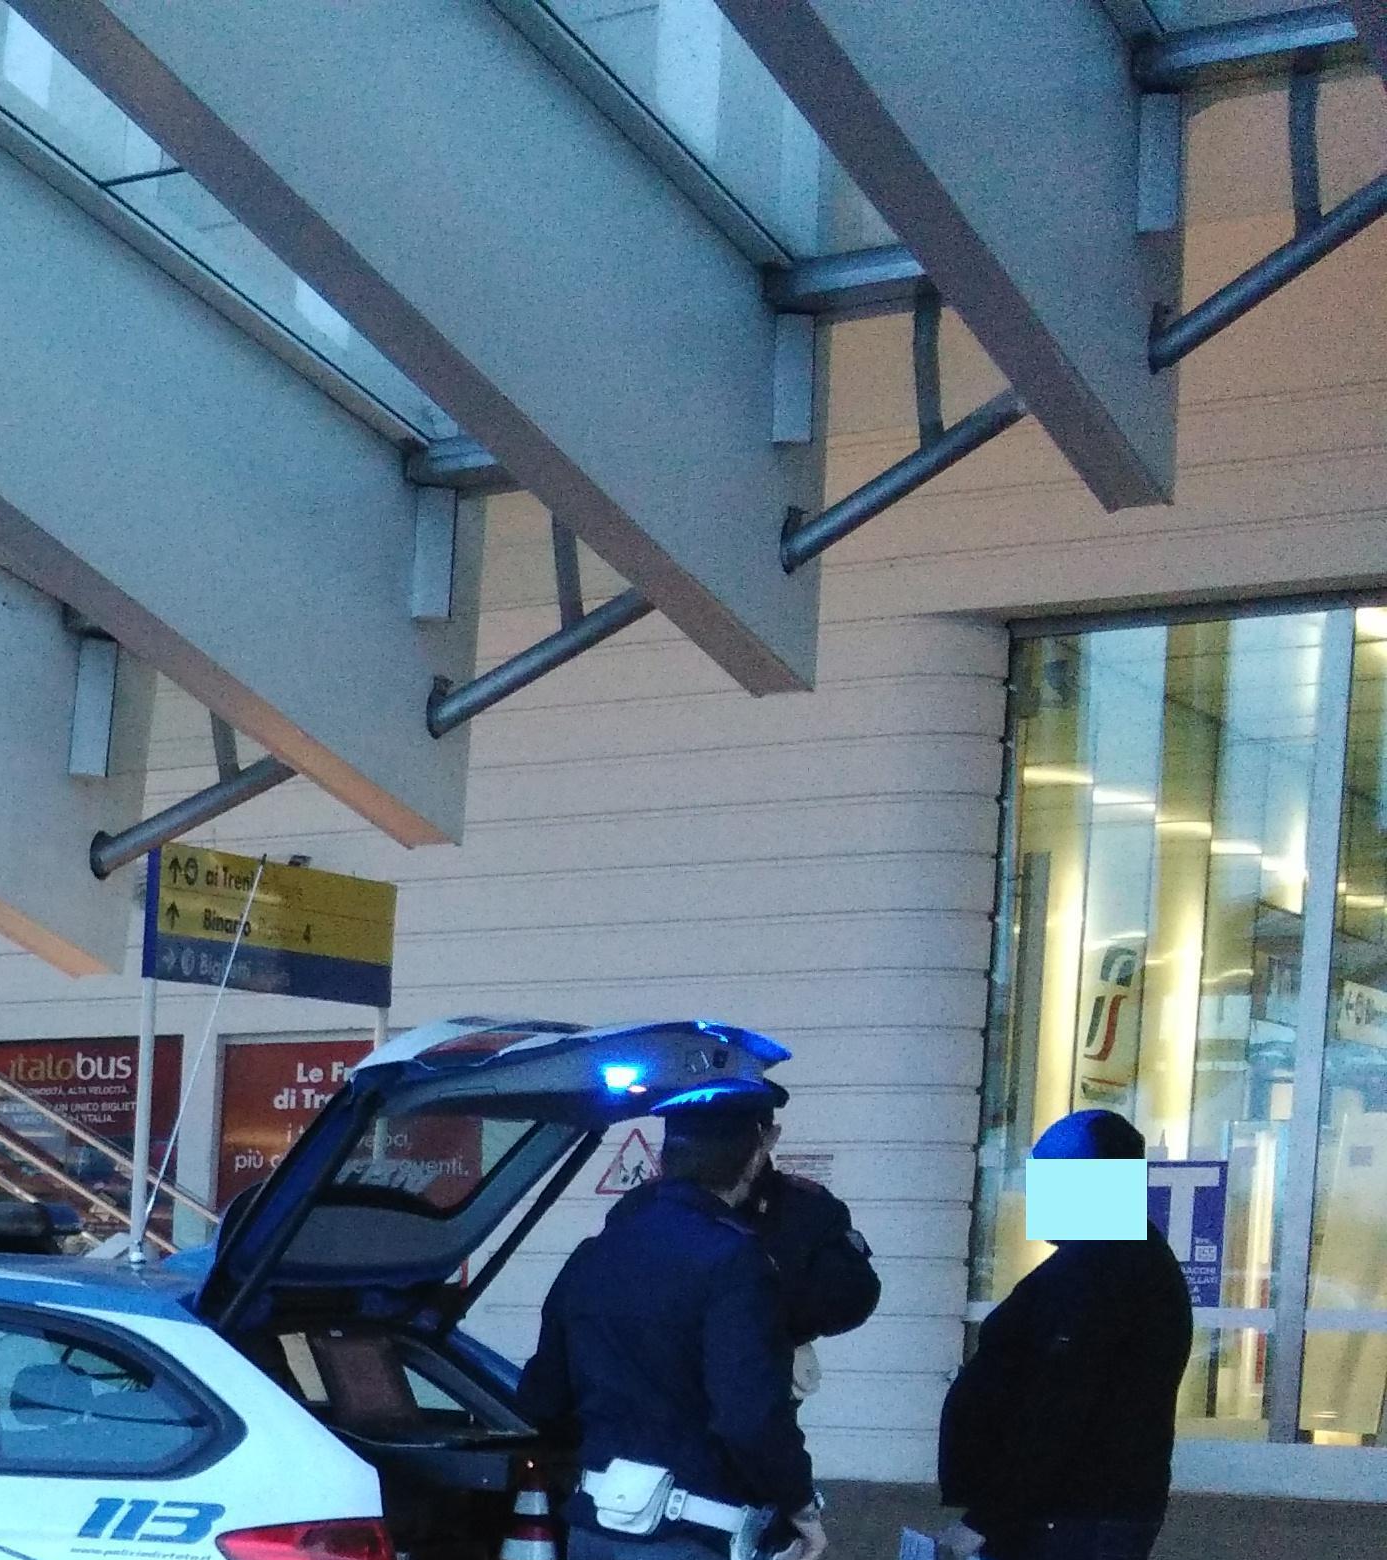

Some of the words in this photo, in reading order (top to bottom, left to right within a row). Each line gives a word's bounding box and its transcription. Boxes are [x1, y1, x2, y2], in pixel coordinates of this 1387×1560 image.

[206, 865, 218, 887] ai
[10, 1051, 132, 1081] italobus
[296, 1062, 323, 1083] Le
[331, 1061, 354, 1082] Fr
[101, 1101, 137, 1112] BIGLIET
[273, 1088, 296, 1110] di
[234, 1149, 264, 1172] più
[78, 1497, 226, 1544] 113
